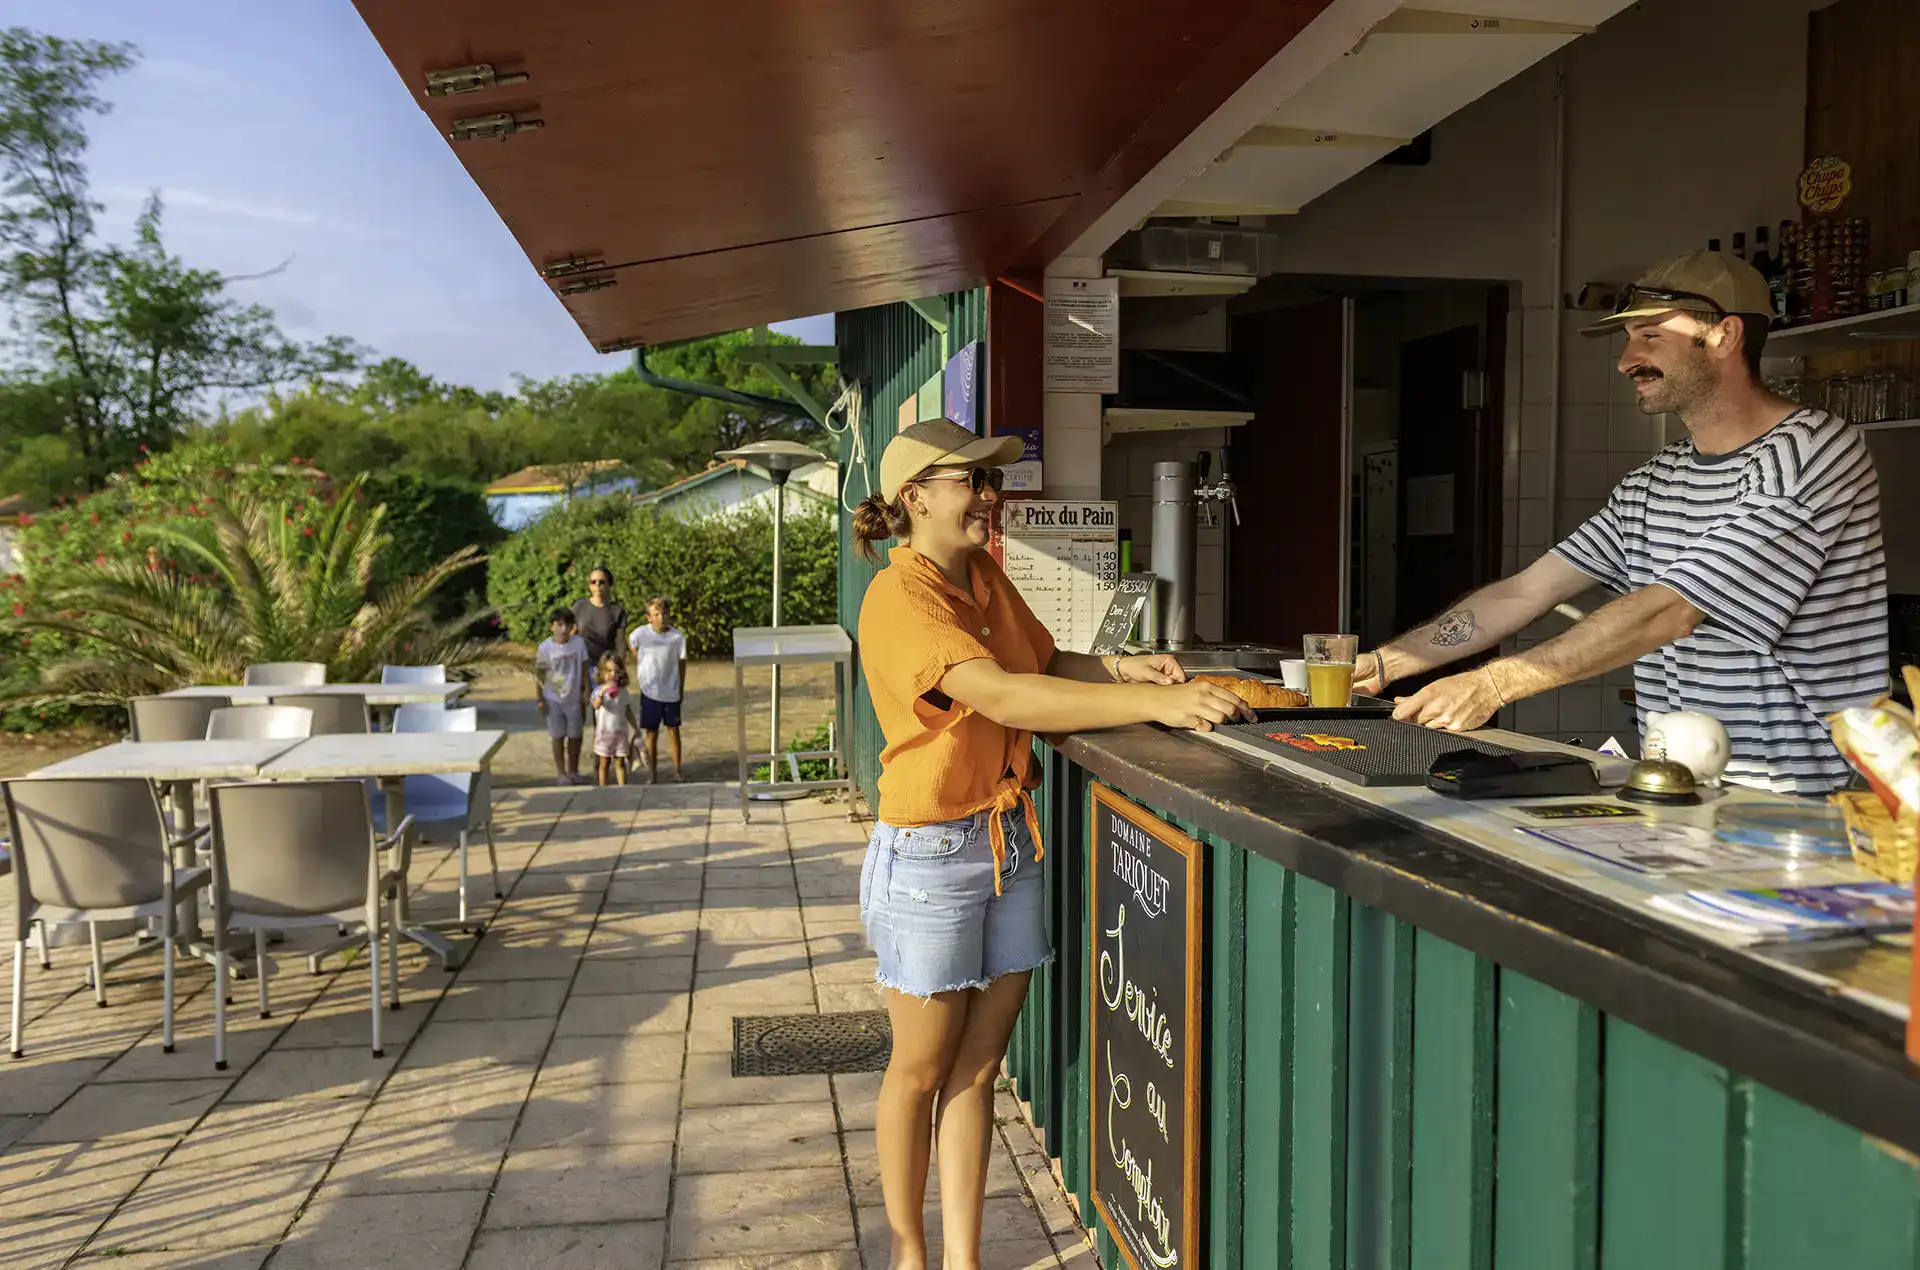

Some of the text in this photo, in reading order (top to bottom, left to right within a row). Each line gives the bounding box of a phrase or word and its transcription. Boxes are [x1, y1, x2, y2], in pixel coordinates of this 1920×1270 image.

[1804, 181, 1843, 205] Chups
[1806, 169, 1843, 185] Chupa
[1025, 505, 1115, 526] Prix du Pain
[1117, 579, 1151, 594] PRESSION
[1111, 814, 1152, 858] DOMAINE
[1110, 840, 1170, 919] TARIQUET
[1100, 903, 1174, 1069] Service
[1146, 1081, 1170, 1145] au
[1107, 1039, 1178, 1268] Comptoir
